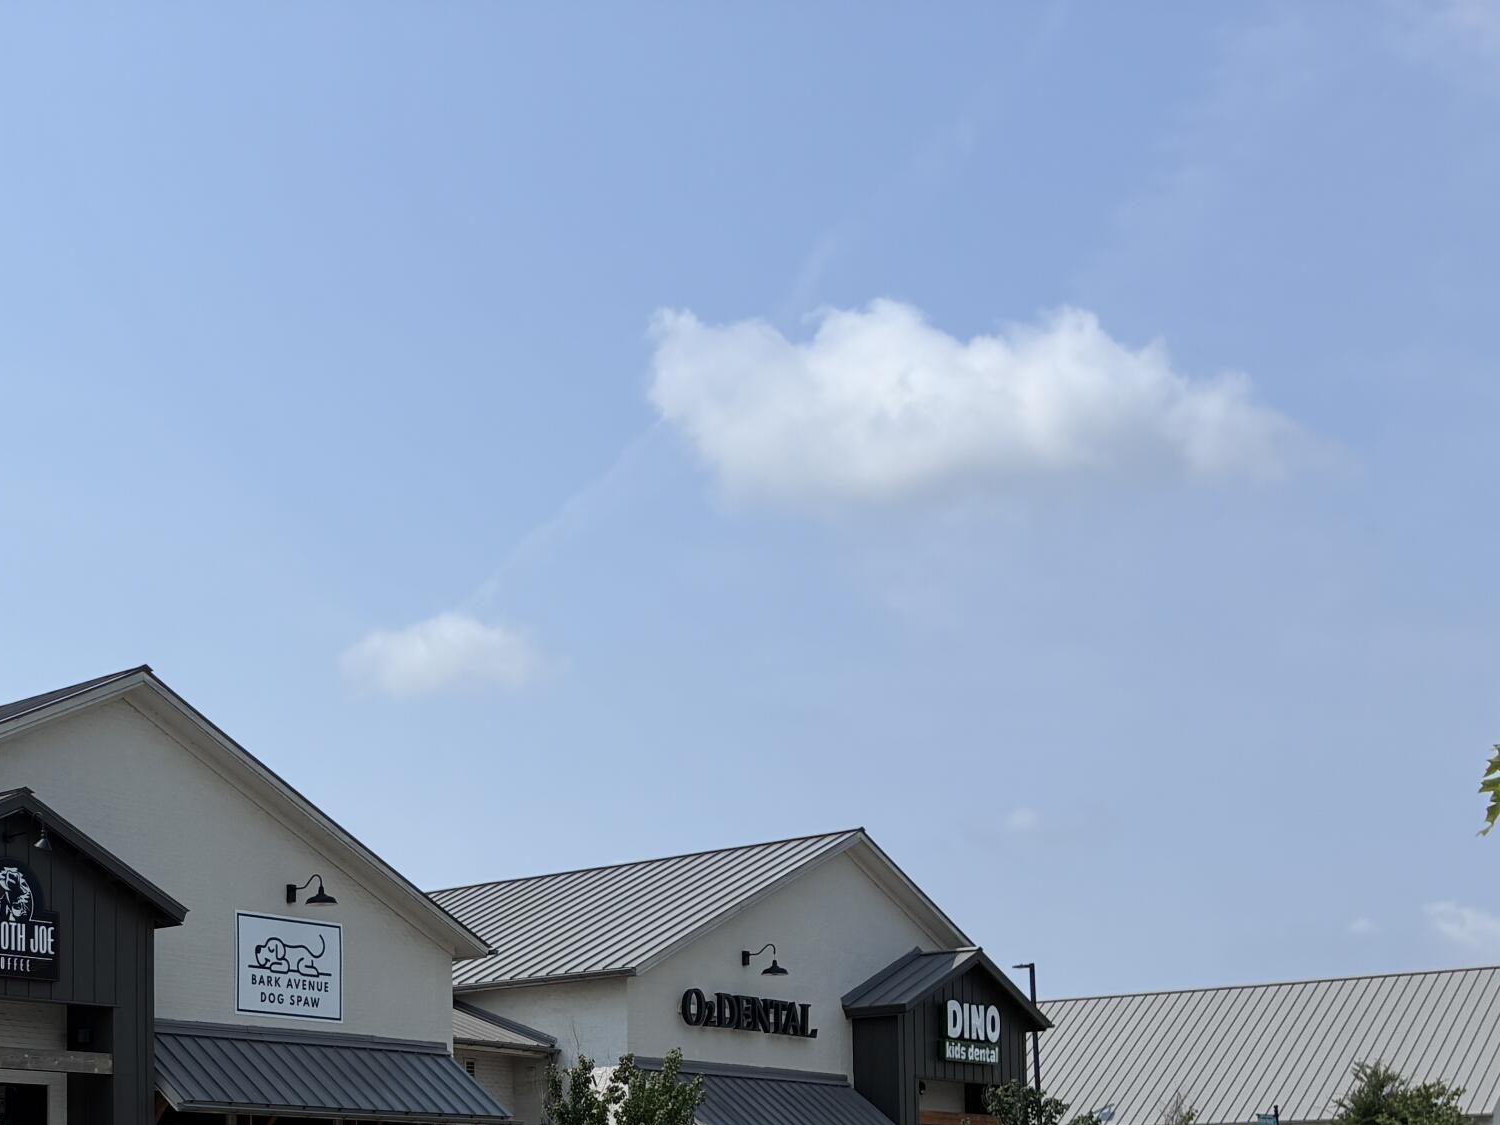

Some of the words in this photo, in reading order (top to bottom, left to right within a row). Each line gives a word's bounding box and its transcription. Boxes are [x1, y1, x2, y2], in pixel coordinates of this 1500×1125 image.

[30, 925, 55, 955] JOE
[251, 974, 281, 988] BARK
[286, 978, 329, 992] AVENUE
[260, 992, 284, 1004] DOG
[289, 995, 320, 1008] SPAW
[947, 999, 1001, 1043] DINO
[946, 1041, 967, 1060] kids
[967, 1044, 999, 1064] dental
